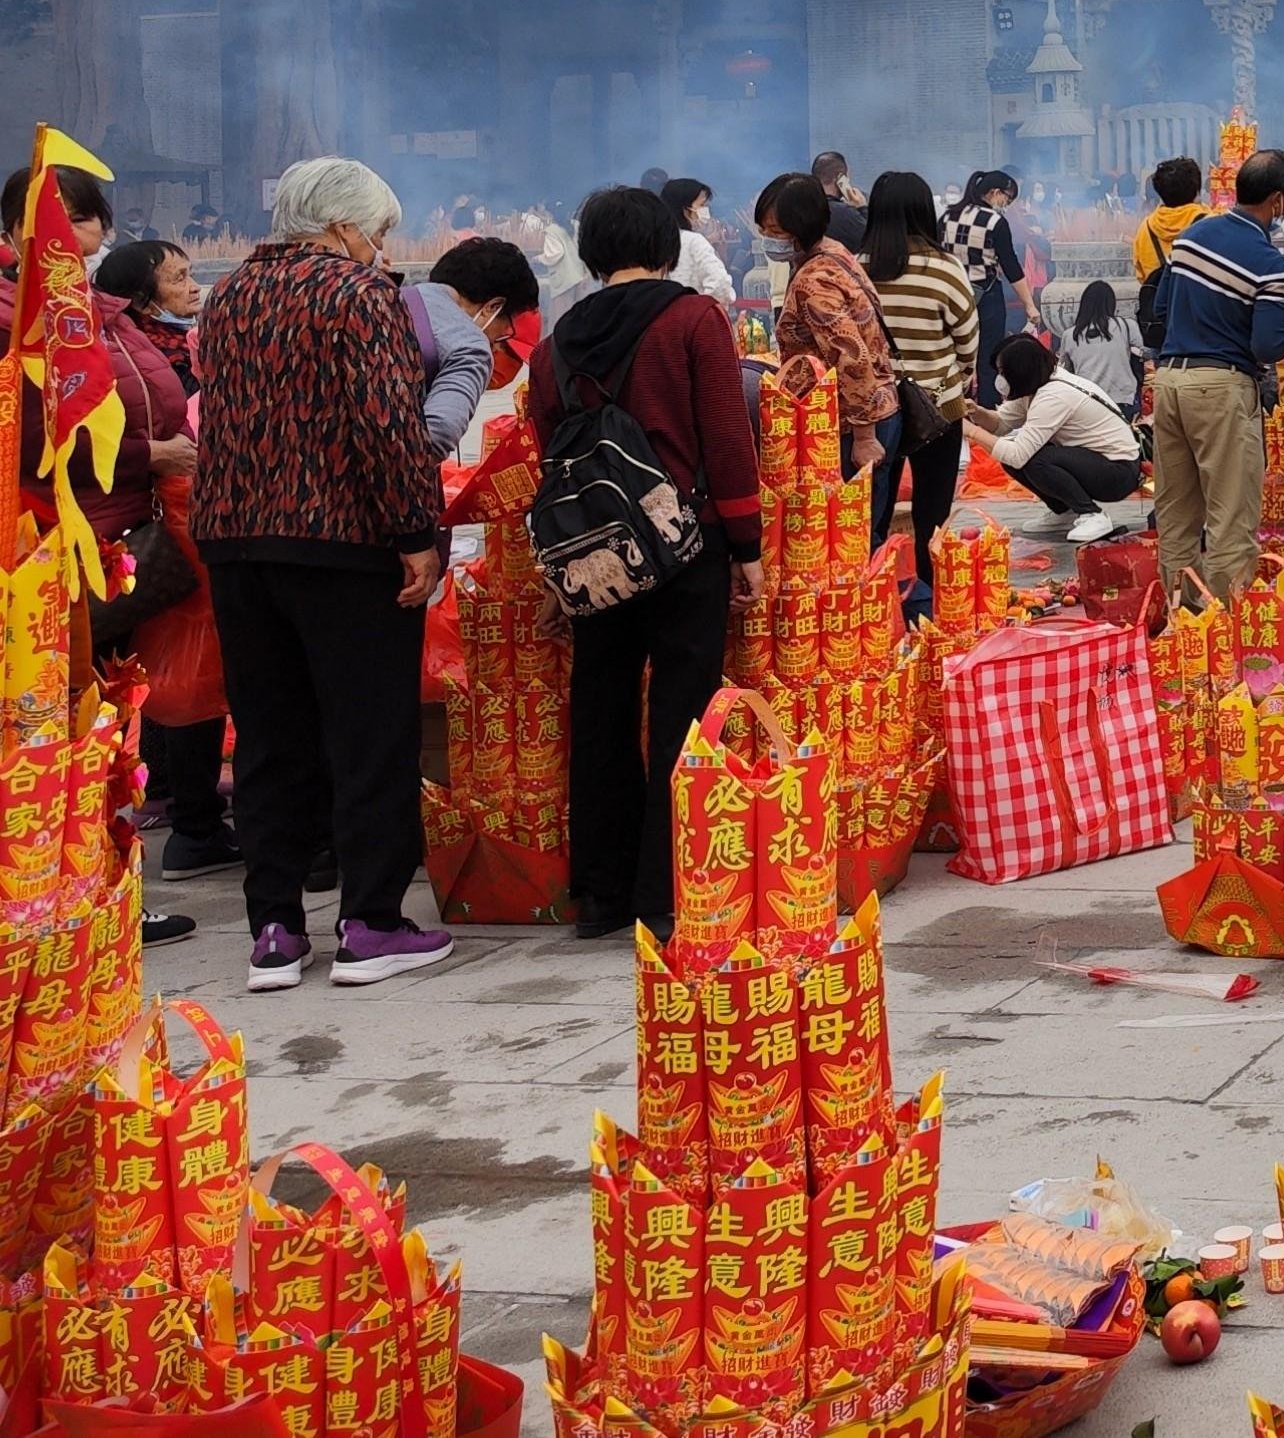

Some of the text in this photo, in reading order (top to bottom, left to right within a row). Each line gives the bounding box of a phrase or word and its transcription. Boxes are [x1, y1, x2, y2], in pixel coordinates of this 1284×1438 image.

[766, 395, 797, 437] 健康
[805, 389, 831, 435] 身體
[836, 484, 863, 529] 學業
[862, 579, 886, 623] 丁財
[949, 545, 975, 587] 健康
[983, 543, 1009, 585] 身體
[478, 601, 507, 644] 兩旺
[795, 592, 819, 635] 兩旺
[822, 589, 849, 632] 丁財
[1256, 602, 1282, 648] 健康
[1151, 639, 1176, 677] 有求
[480, 693, 511, 744] 必應
[535, 693, 563, 744] 必應
[844, 680, 867, 729] 有求
[1, 756, 46, 838] 合家
[73, 736, 110, 817] 合家
[760, 765, 812, 867] 有求
[866, 786, 892, 830] 生意
[703, 775, 755, 871] 必應
[1255, 816, 1281, 866] 平安
[24, 933, 80, 1020] 龍母
[800, 963, 855, 1056] 龍母
[653, 982, 697, 1075] 賜福
[703, 982, 740, 1075] 龍母
[745, 970, 798, 1070] 賜福
[110, 1110, 164, 1196] 健康
[176, 1098, 234, 1189] 身體
[818, 1180, 876, 1278] 生意
[899, 1149, 934, 1237] 生意
[268, 1233, 325, 1316] 必應
[641, 1204, 698, 1301] 興隆
[705, 1203, 753, 1298] 生意
[756, 1193, 808, 1298] 興隆
[56, 1307, 103, 1394] 必應
[101, 1301, 140, 1400] 有求
[416, 1307, 457, 1395] 身體
